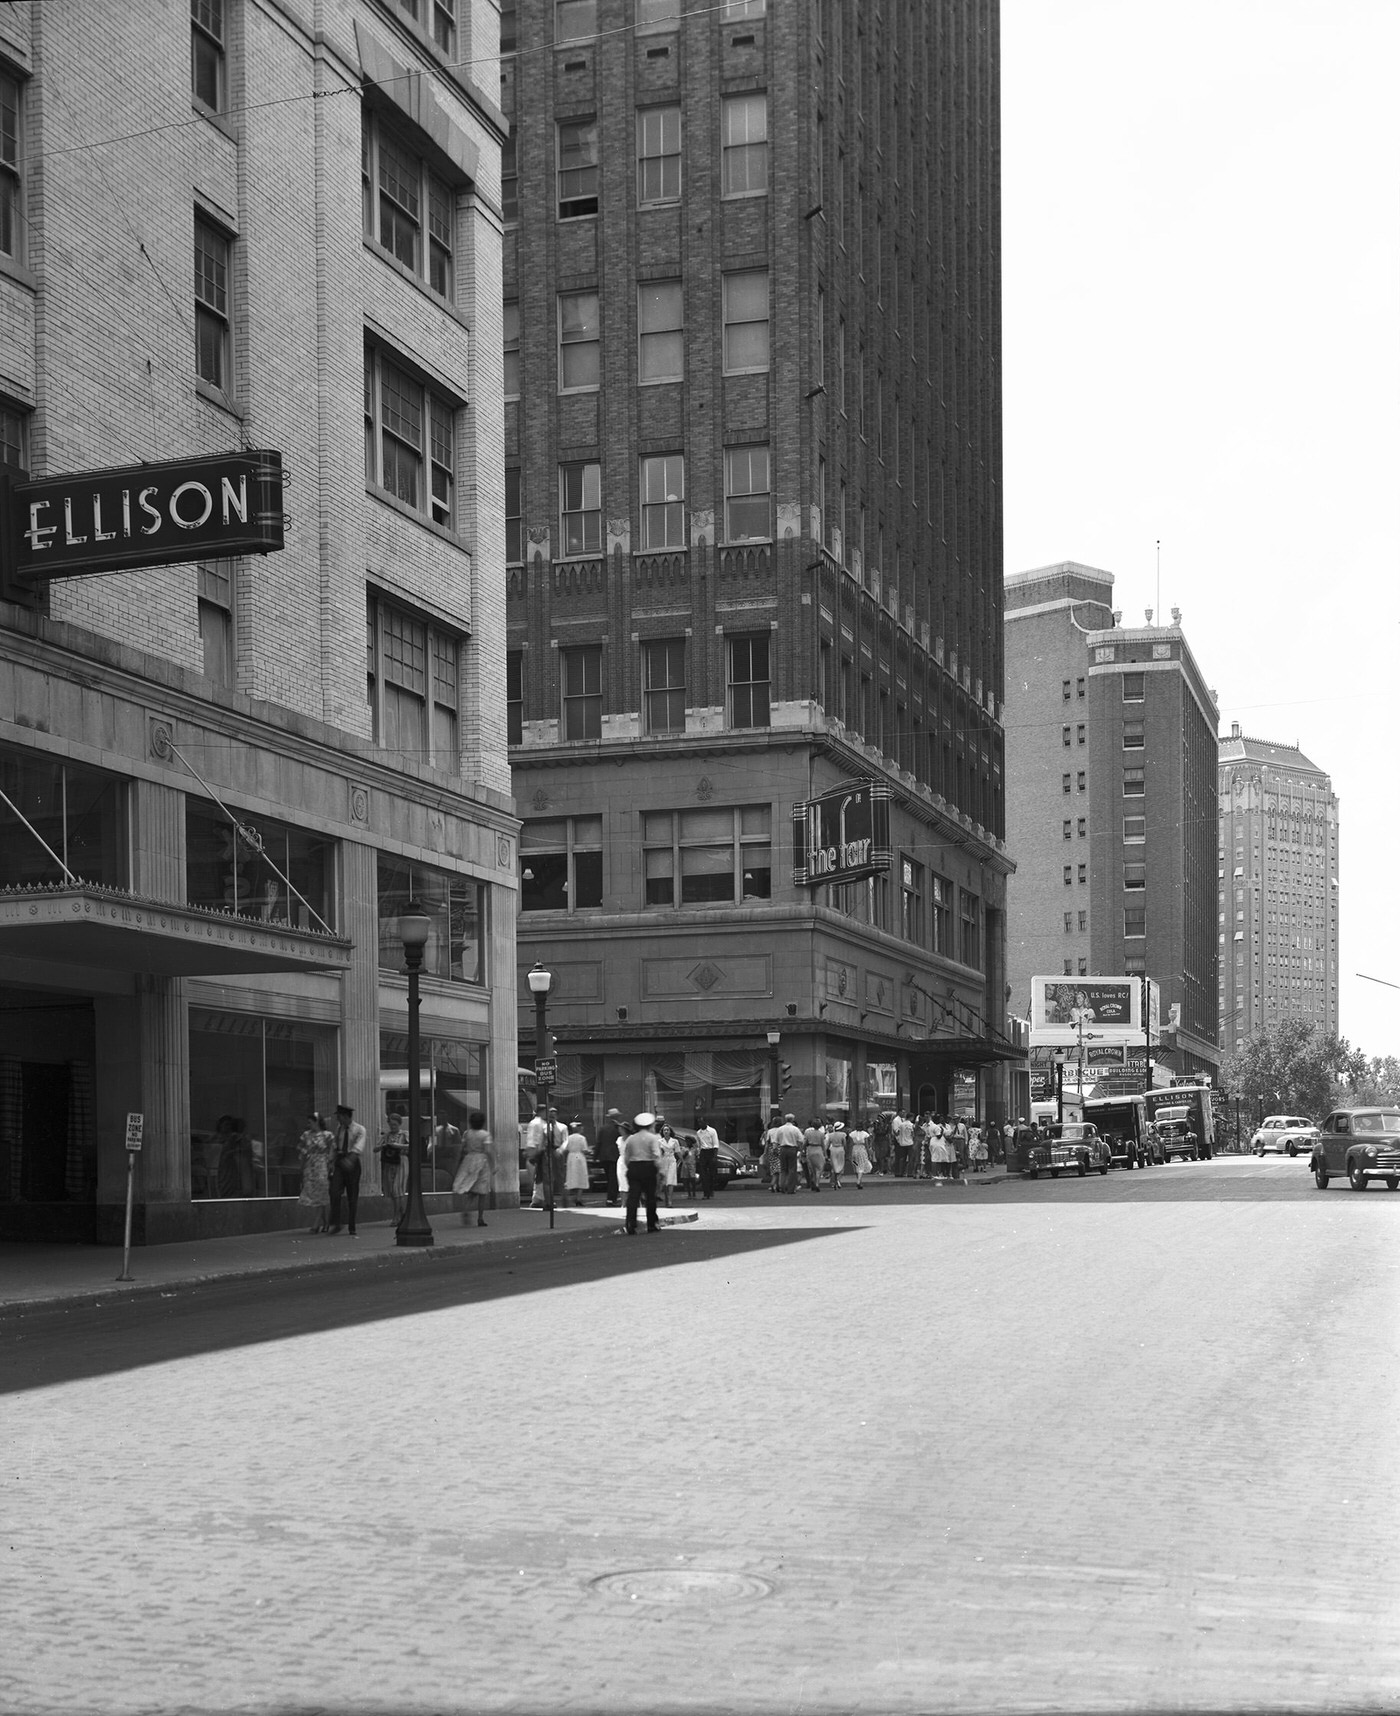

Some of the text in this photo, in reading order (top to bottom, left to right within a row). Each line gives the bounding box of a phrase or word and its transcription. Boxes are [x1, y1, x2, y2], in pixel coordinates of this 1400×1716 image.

[23, 474, 248, 550] ELLISON
[1099, 1003, 1110, 1012] ROYAL
[1089, 1047, 1123, 1058] ROYAL CROWN
[1153, 1093, 1194, 1102] ELLISON
[130, 1115, 141, 1123] BUS
[128, 1124, 142, 1132] ZONE
